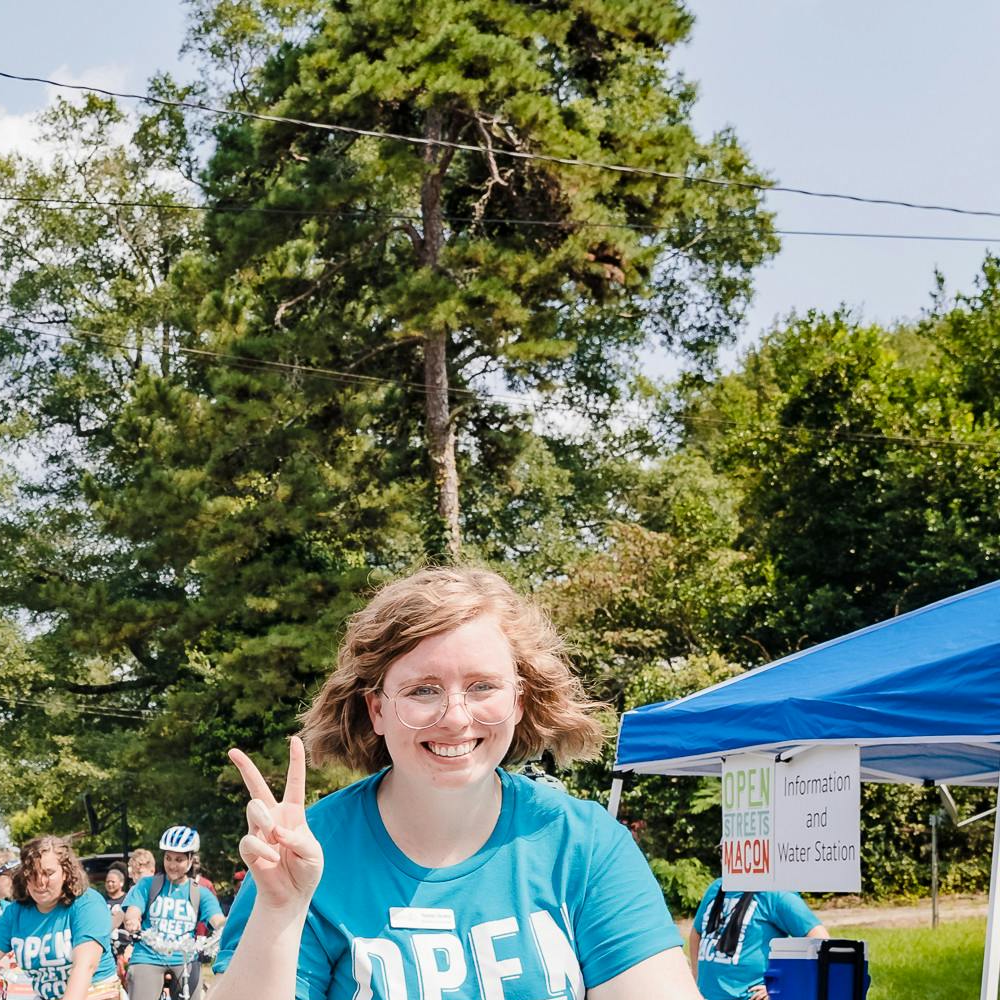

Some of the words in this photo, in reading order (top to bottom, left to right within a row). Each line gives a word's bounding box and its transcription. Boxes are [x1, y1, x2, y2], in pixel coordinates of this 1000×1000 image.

[725, 767, 770, 808] OPEN
[784, 771, 851, 797] Information
[724, 810, 770, 838] STREETS
[806, 807, 828, 828] and
[725, 839, 770, 874] MACON
[778, 842, 811, 863] Water
[815, 840, 856, 862] Station
